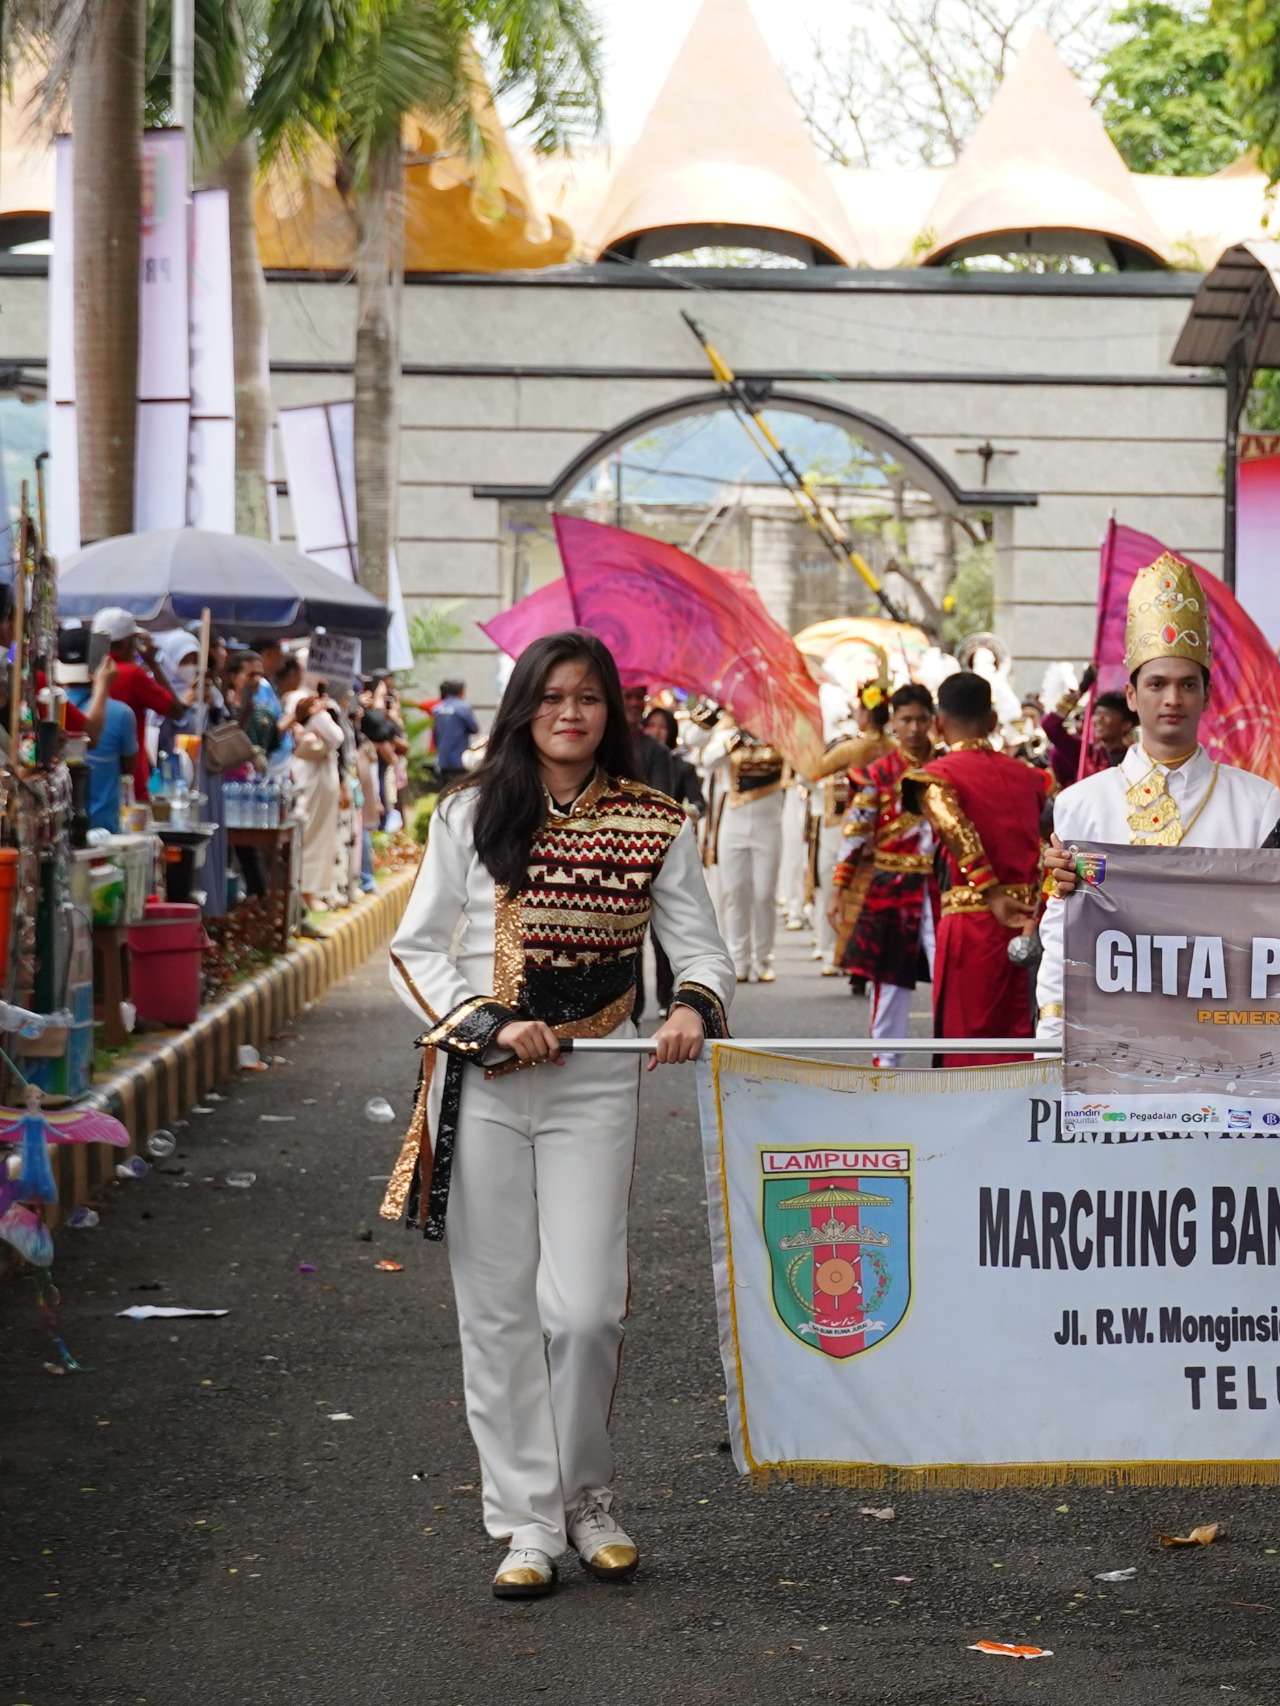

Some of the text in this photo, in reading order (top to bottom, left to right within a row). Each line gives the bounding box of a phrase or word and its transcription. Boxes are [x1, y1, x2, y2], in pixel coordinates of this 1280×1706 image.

[1095, 929, 1228, 999] GITA
[1064, 1109, 1100, 1117] mandiri
[1130, 1112, 1177, 1121] Pegadaian
[1181, 1113, 1210, 1123] GGF
[769, 1153, 902, 1171] LAMPUNG
[979, 1186, 1197, 1270] MARCHING
